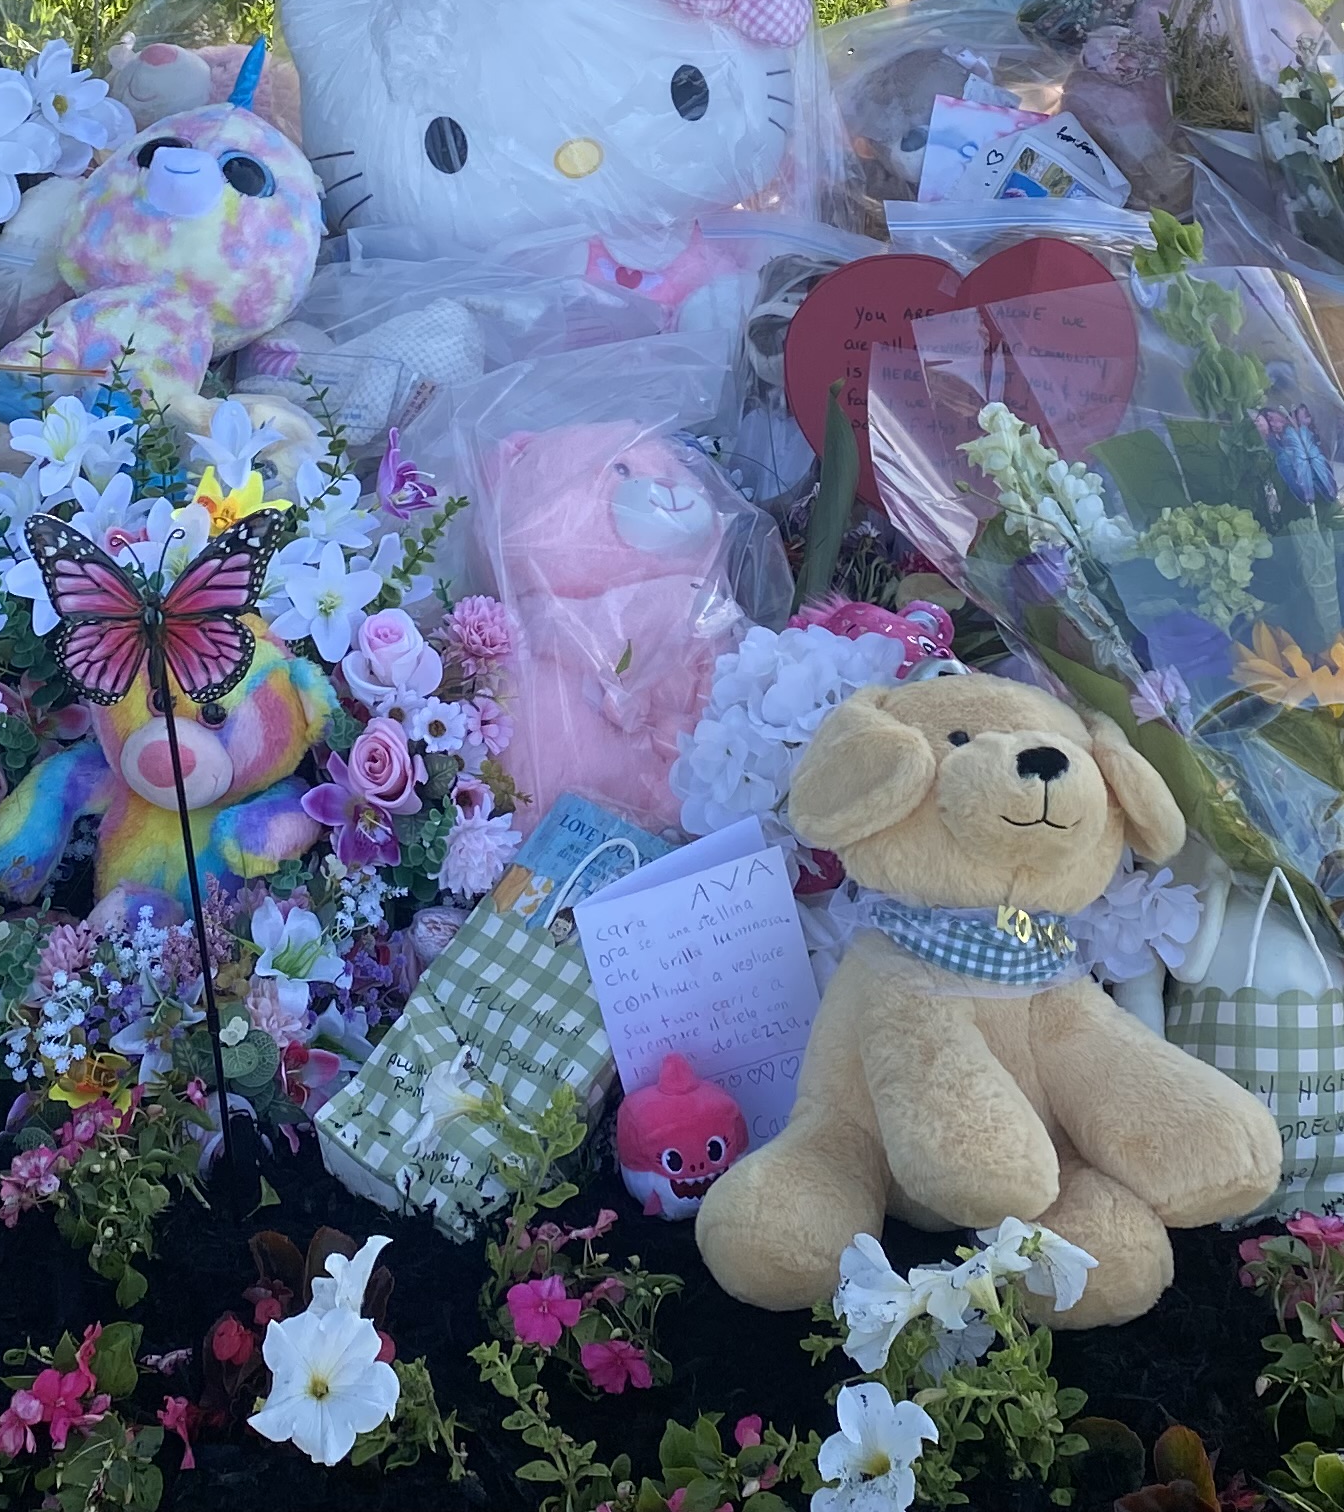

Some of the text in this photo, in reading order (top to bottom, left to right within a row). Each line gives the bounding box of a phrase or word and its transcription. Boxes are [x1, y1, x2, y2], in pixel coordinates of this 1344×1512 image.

[882, 367, 921, 382] HERE
[559, 814, 599, 842] LOVE
[690, 858, 774, 910] AVA
[667, 926, 690, 940] una
[698, 898, 754, 931] stellina
[658, 947, 703, 971] brilla
[711, 971, 723, 983] a
[731, 945, 785, 974] vegliare
[770, 979, 784, 992] a
[467, 986, 516, 1030] FLY
[767, 1000, 789, 1013] con
[1280, 1154, 1320, 1186] gel
